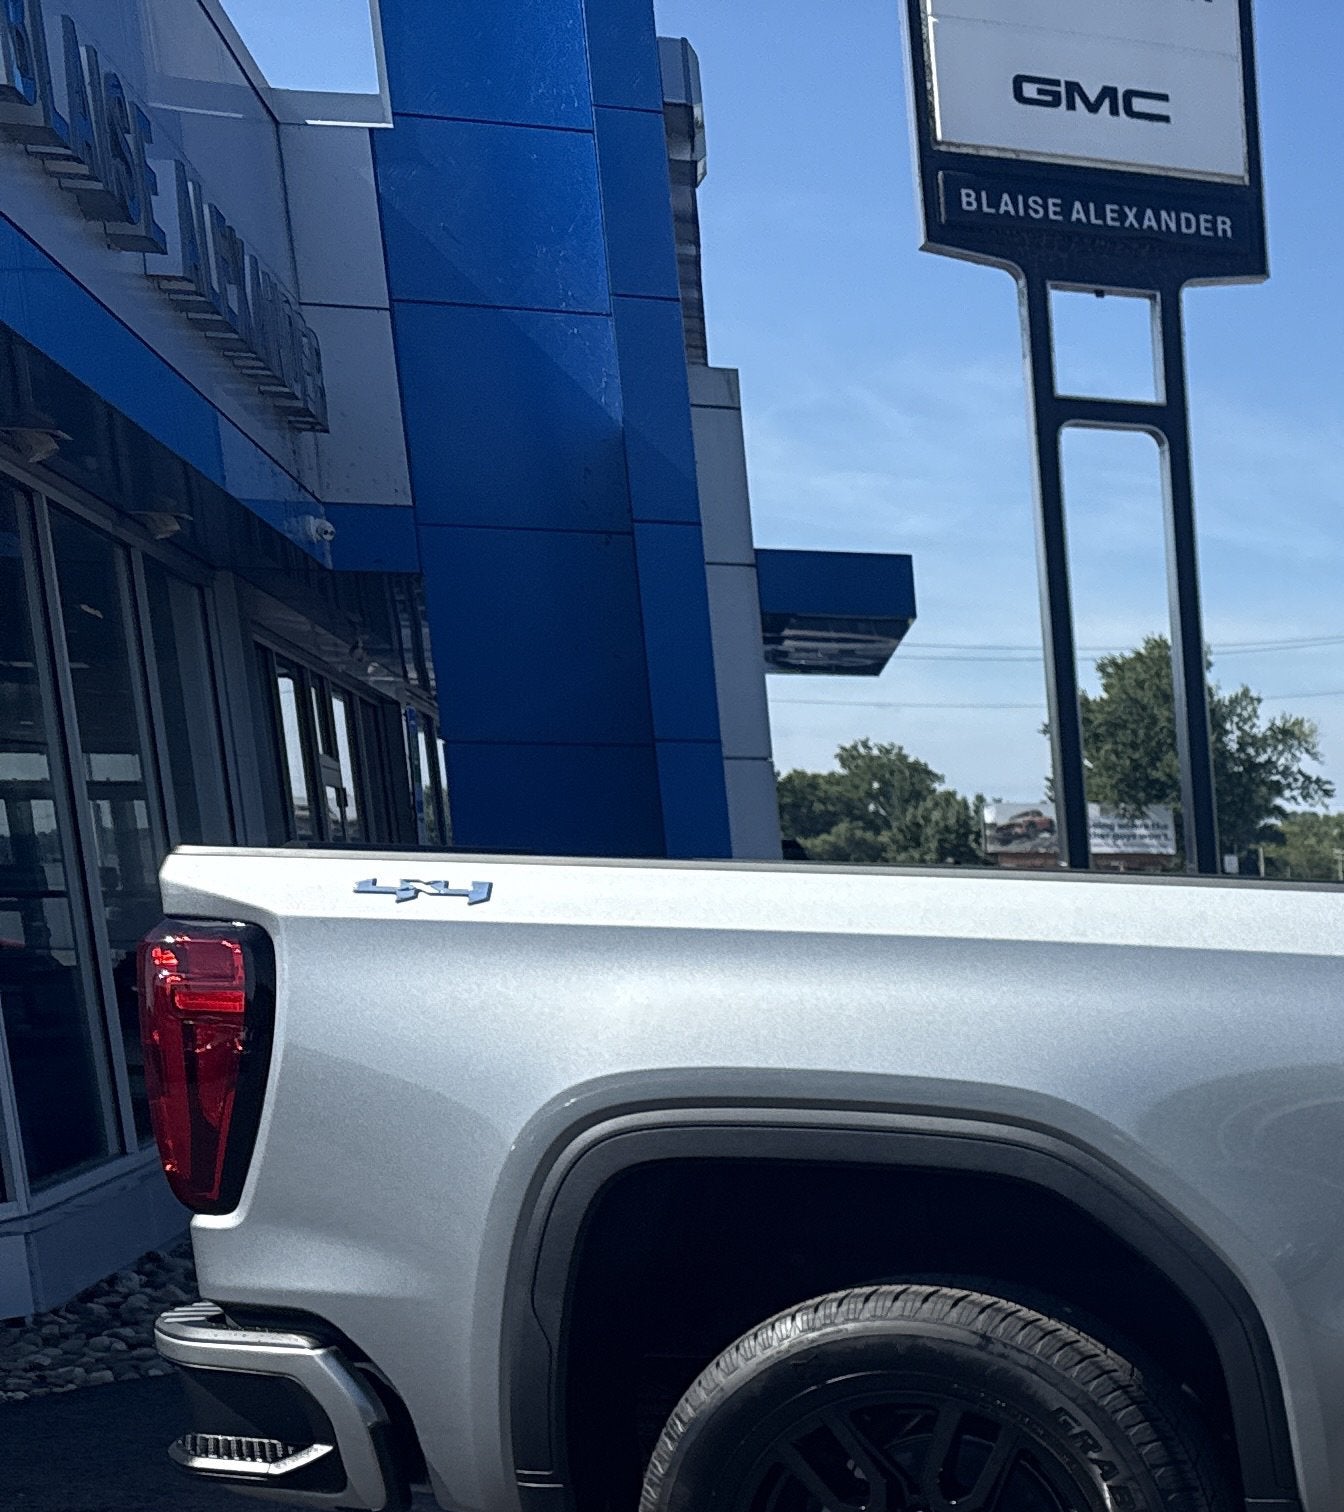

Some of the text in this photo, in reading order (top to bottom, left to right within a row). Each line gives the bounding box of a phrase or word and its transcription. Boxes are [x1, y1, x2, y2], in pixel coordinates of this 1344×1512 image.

[1012, 73, 1171, 124] GMC
[960, 187, 1233, 239] BLAISE ALEXANDER
